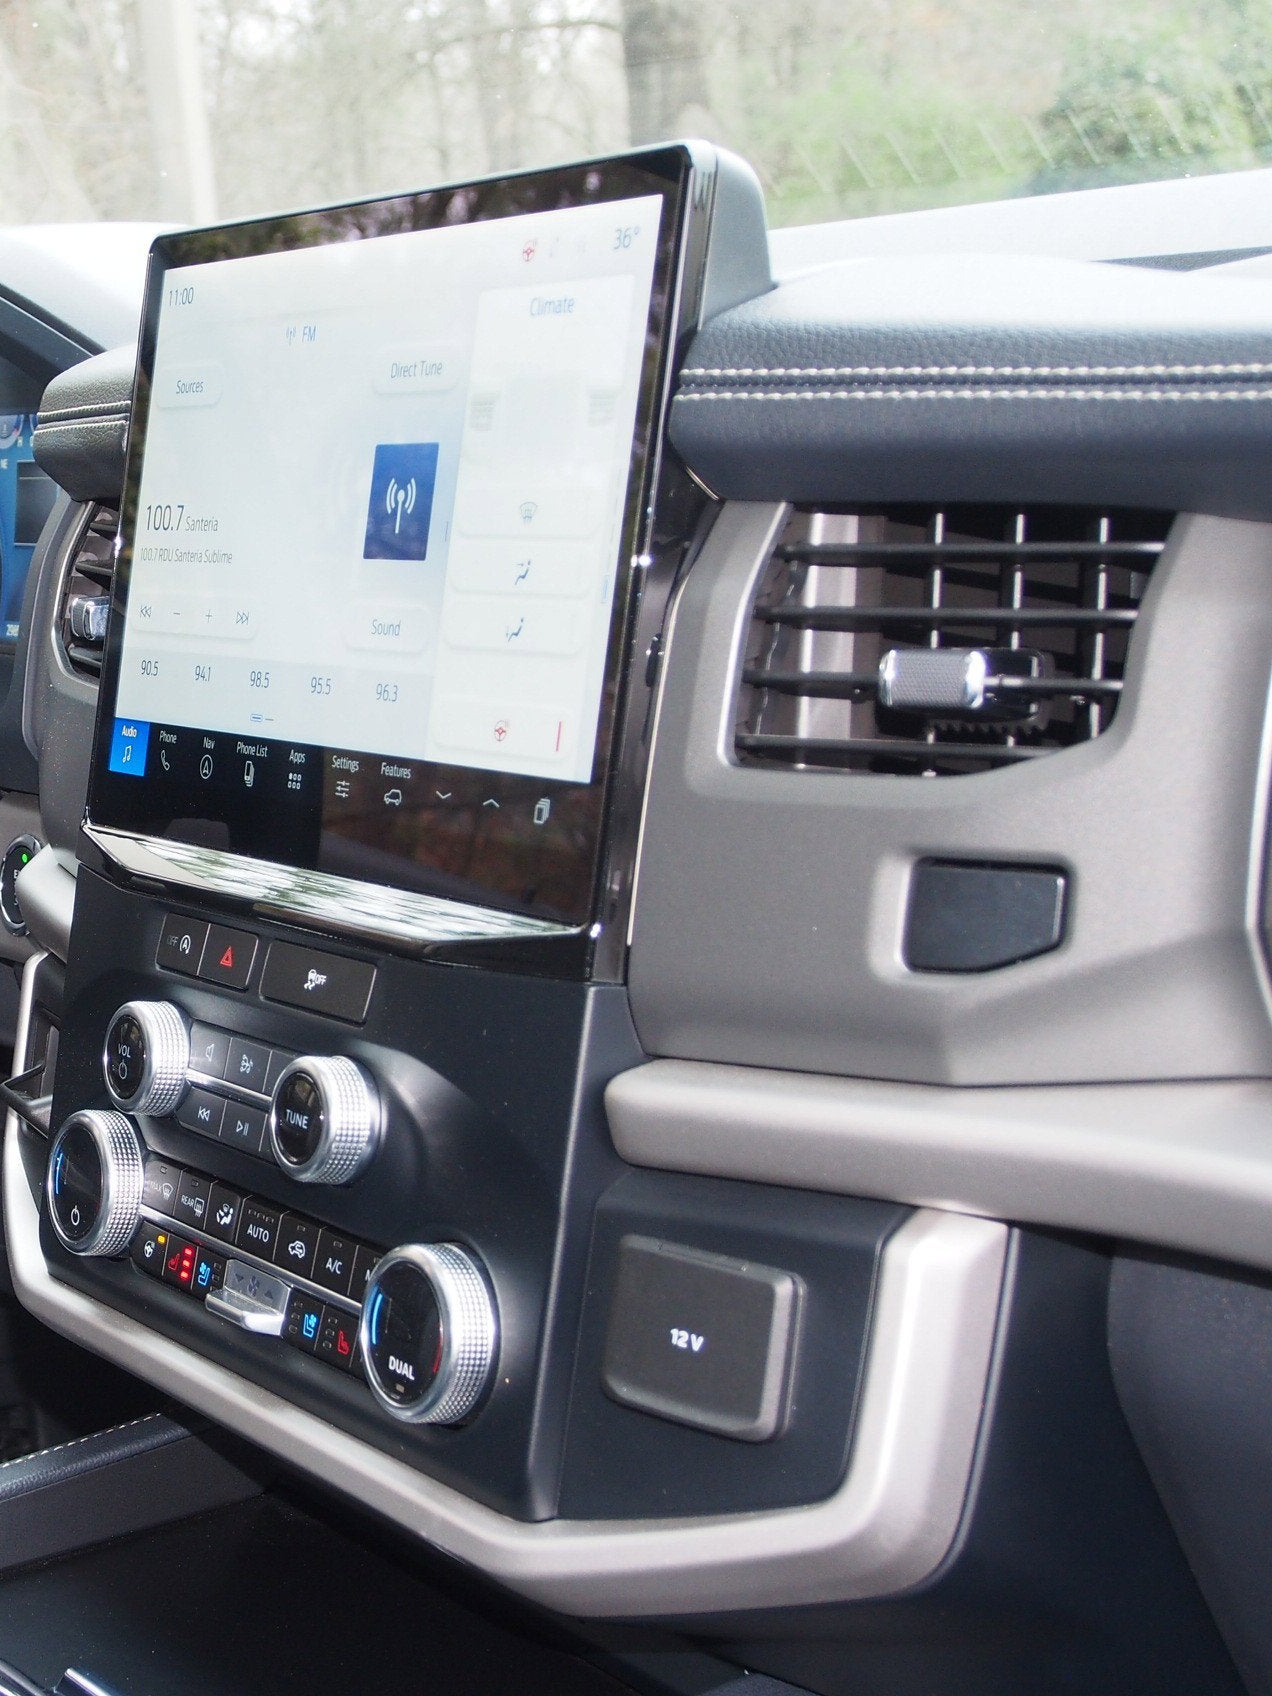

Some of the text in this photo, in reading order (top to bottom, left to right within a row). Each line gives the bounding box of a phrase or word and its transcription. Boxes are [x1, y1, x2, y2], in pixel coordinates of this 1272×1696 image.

[169, 286, 195, 306] 11:00
[529, 296, 575, 316] Climate
[302, 325, 317, 342] FM
[390, 360, 443, 378] Direct Tune
[176, 379, 204, 395] Sources
[146, 504, 219, 532] 100.7 Santeria
[140, 547, 233, 564] 100.7 RDU Santeria Sublime
[371, 619, 402, 636] Sound
[141, 659, 399, 702] 90.5 94.1 98.5 95.5 96.3
[121, 725, 138, 738] Audio
[159, 730, 178, 744] Phone
[203, 736, 216, 750] Nav
[236, 741, 268, 757] Phone List
[288, 749, 306, 764] Apps
[332, 755, 360, 773] Settings
[380, 762, 412, 779] Features
[315, 974, 327, 985] OFF
[118, 1043, 131, 1058] VOL
[286, 1108, 309, 1129] TUNE
[181, 1194, 194, 1207] REAR
[247, 1223, 269, 1243] AUTO
[326, 1257, 343, 1275] A/C
[388, 1355, 415, 1381] DUAL
